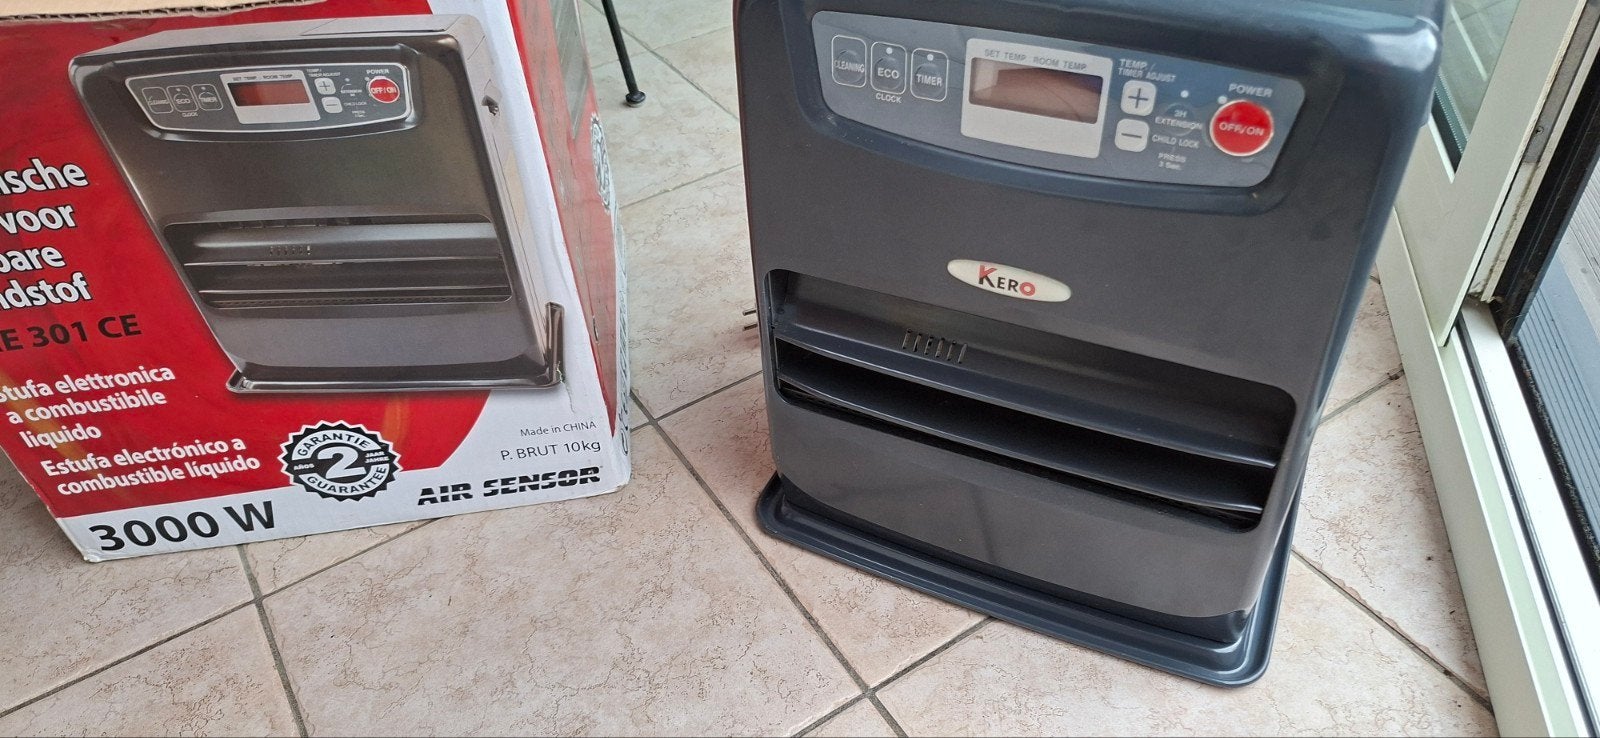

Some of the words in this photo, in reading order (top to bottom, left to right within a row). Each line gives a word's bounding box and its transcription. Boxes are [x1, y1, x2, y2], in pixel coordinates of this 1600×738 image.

[834, 60, 865, 73] CLEANING
[984, 48, 1000, 58] SET
[1004, 52, 1026, 62] TEMP
[1032, 56, 1059, 67] ROOM
[1063, 60, 1088, 70] TEMP
[877, 68, 900, 79] ECO
[916, 74, 943, 87] TIMER
[1118, 67, 1144, 79] TIMER
[1146, 70, 1177, 83] ADJUST
[876, 92, 902, 104] CLOCK
[1228, 83, 1274, 98] POWER
[1154, 116, 1203, 130] EXTENSION
[1152, 134, 1176, 146] CHILD
[1178, 138, 1200, 149] LOCK
[1158, 152, 1187, 162] PRESS
[26, 321, 88, 348] 301
[98, 314, 142, 338] CE
[55, 365, 176, 393] elettronica
[6, 410, 24, 425] a
[24, 388, 168, 422] combustibile
[19, 422, 102, 449] liquido
[520, 426, 550, 437] Made
[551, 426, 562, 434] in
[562, 420, 597, 432] CHINA
[298, 432, 372, 456] GARANTIE
[500, 450, 514, 460] P.
[517, 444, 558, 460] BRUT
[564, 440, 601, 453] 10kg
[41, 452, 112, 477] Estufa
[113, 439, 230, 466] electrónico
[230, 438, 247, 450] a
[317, 446, 367, 480] 2
[57, 464, 186, 496] combustible
[187, 454, 261, 480] líquido
[307, 466, 387, 494] GUARANTEE
[418, 482, 473, 506] AIR
[484, 466, 600, 497] SENSOR
[89, 510, 220, 552] 3000
[223, 500, 275, 532] W
